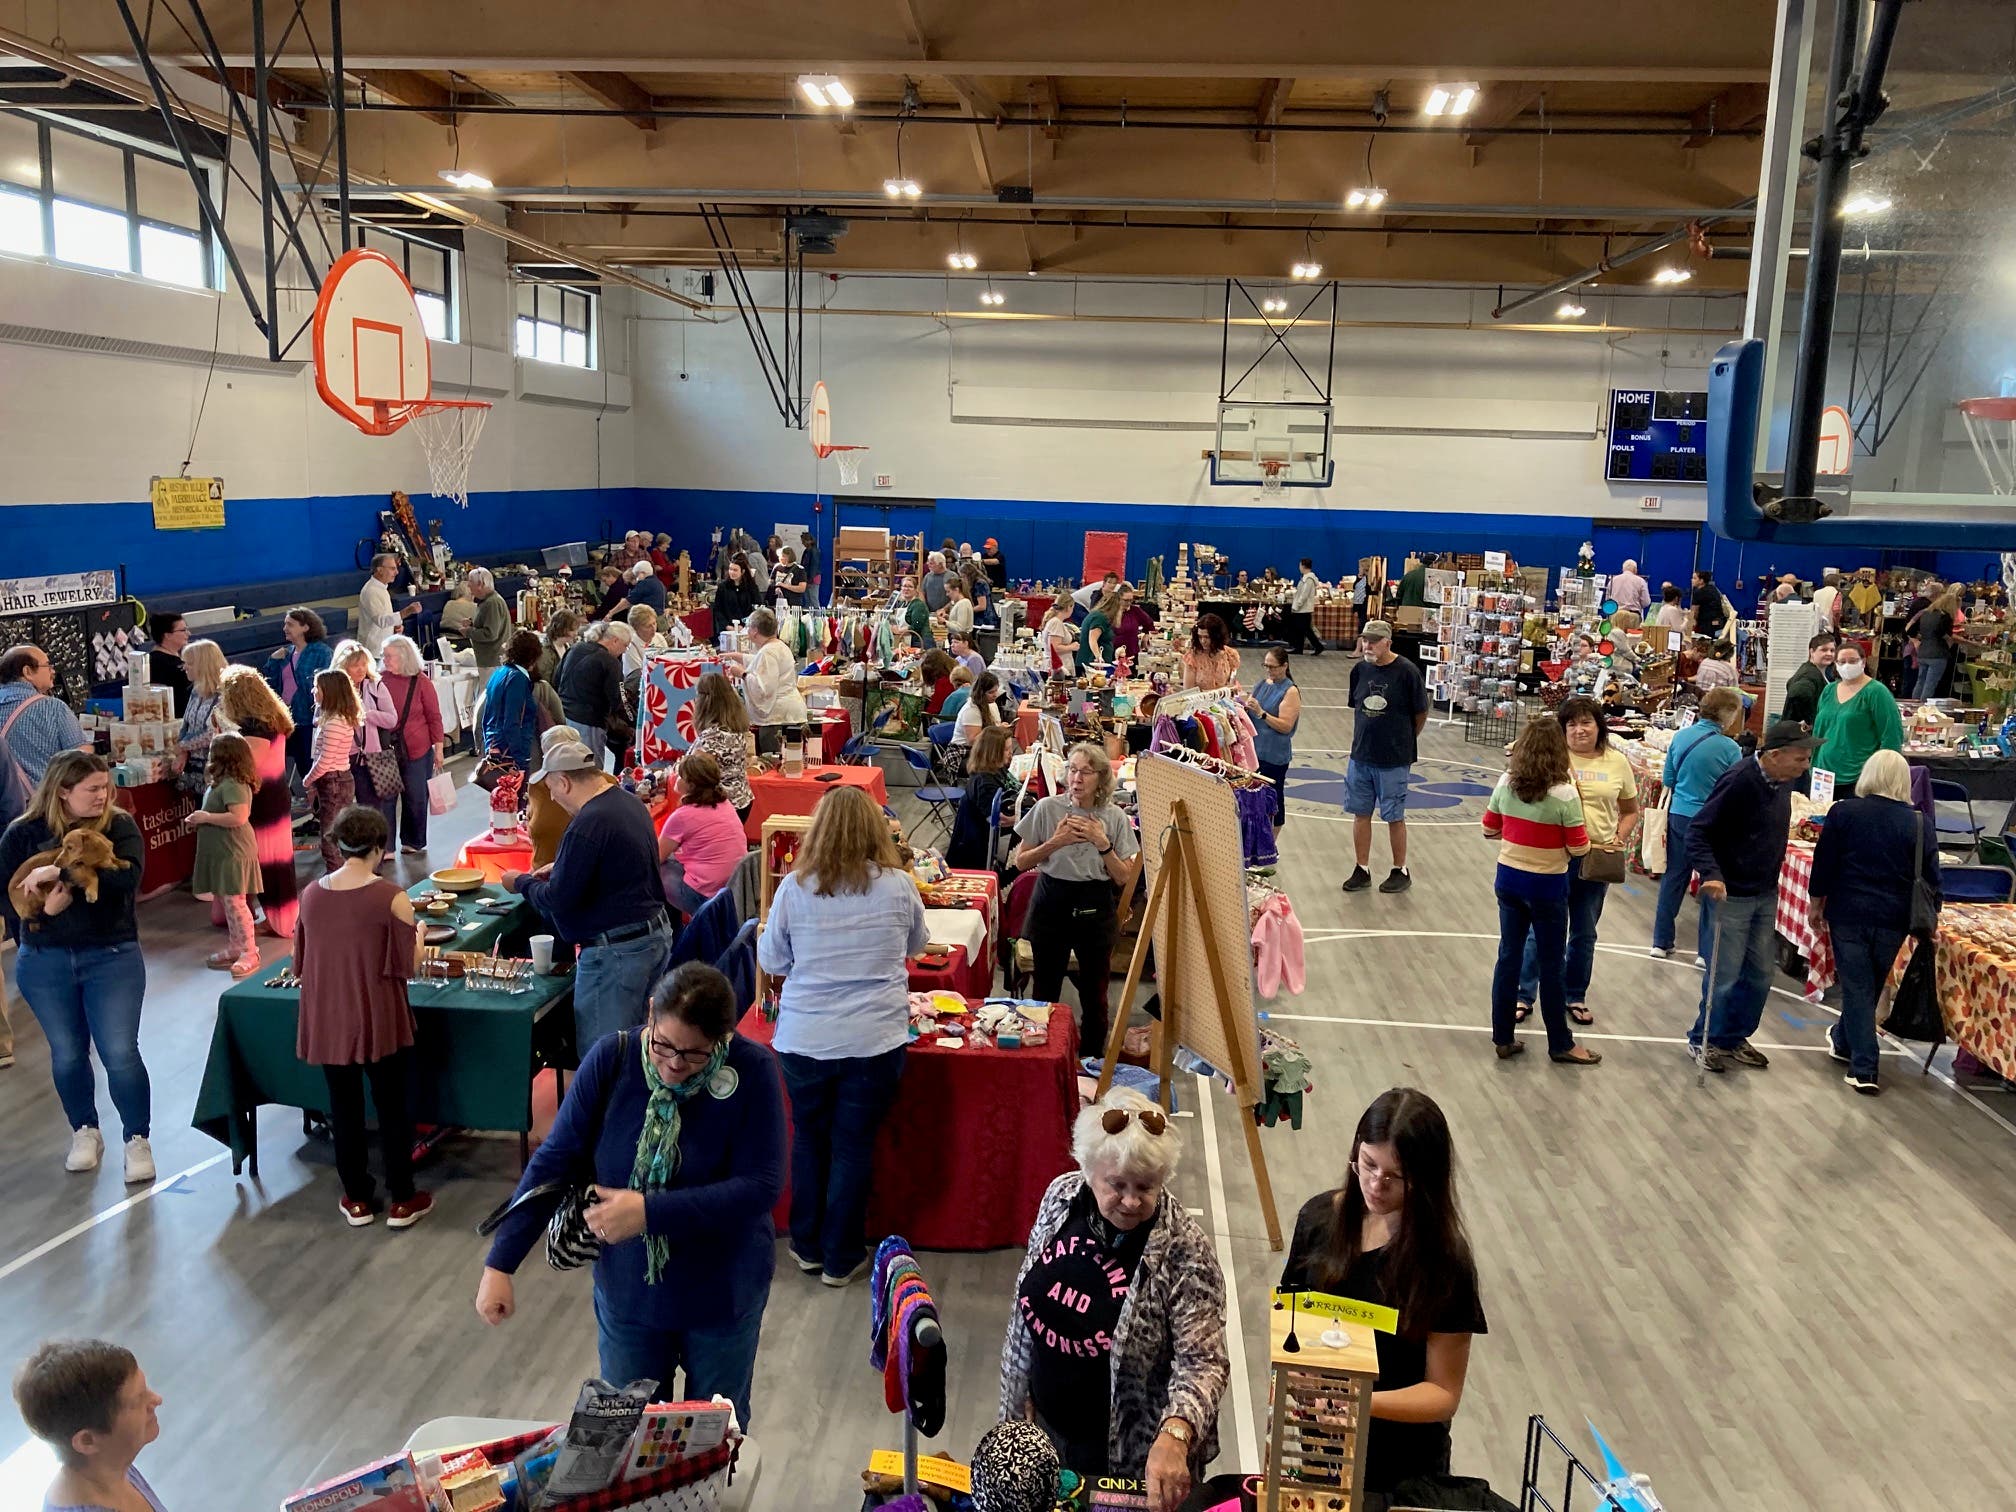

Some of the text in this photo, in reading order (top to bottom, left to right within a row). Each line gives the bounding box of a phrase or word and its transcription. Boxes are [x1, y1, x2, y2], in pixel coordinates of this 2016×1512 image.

[1617, 393, 1650, 404] HOME
[1612, 444, 1635, 452] FOULS
[1670, 446, 1696, 454] PLAYER
[877, 475, 890, 486] EXIT
[1644, 497, 1658, 507] EXIT
[3, 587, 101, 611] HAIR JEWELRY
[1047, 1281, 1091, 1314] AND
[1020, 1296, 1112, 1357] KINDNESS
[585, 1406, 640, 1418] Balloons
[1097, 1477, 1137, 1491] KIND
[293, 1482, 361, 1512] MONOPOLY
[1094, 1491, 1109, 1503] DAY
